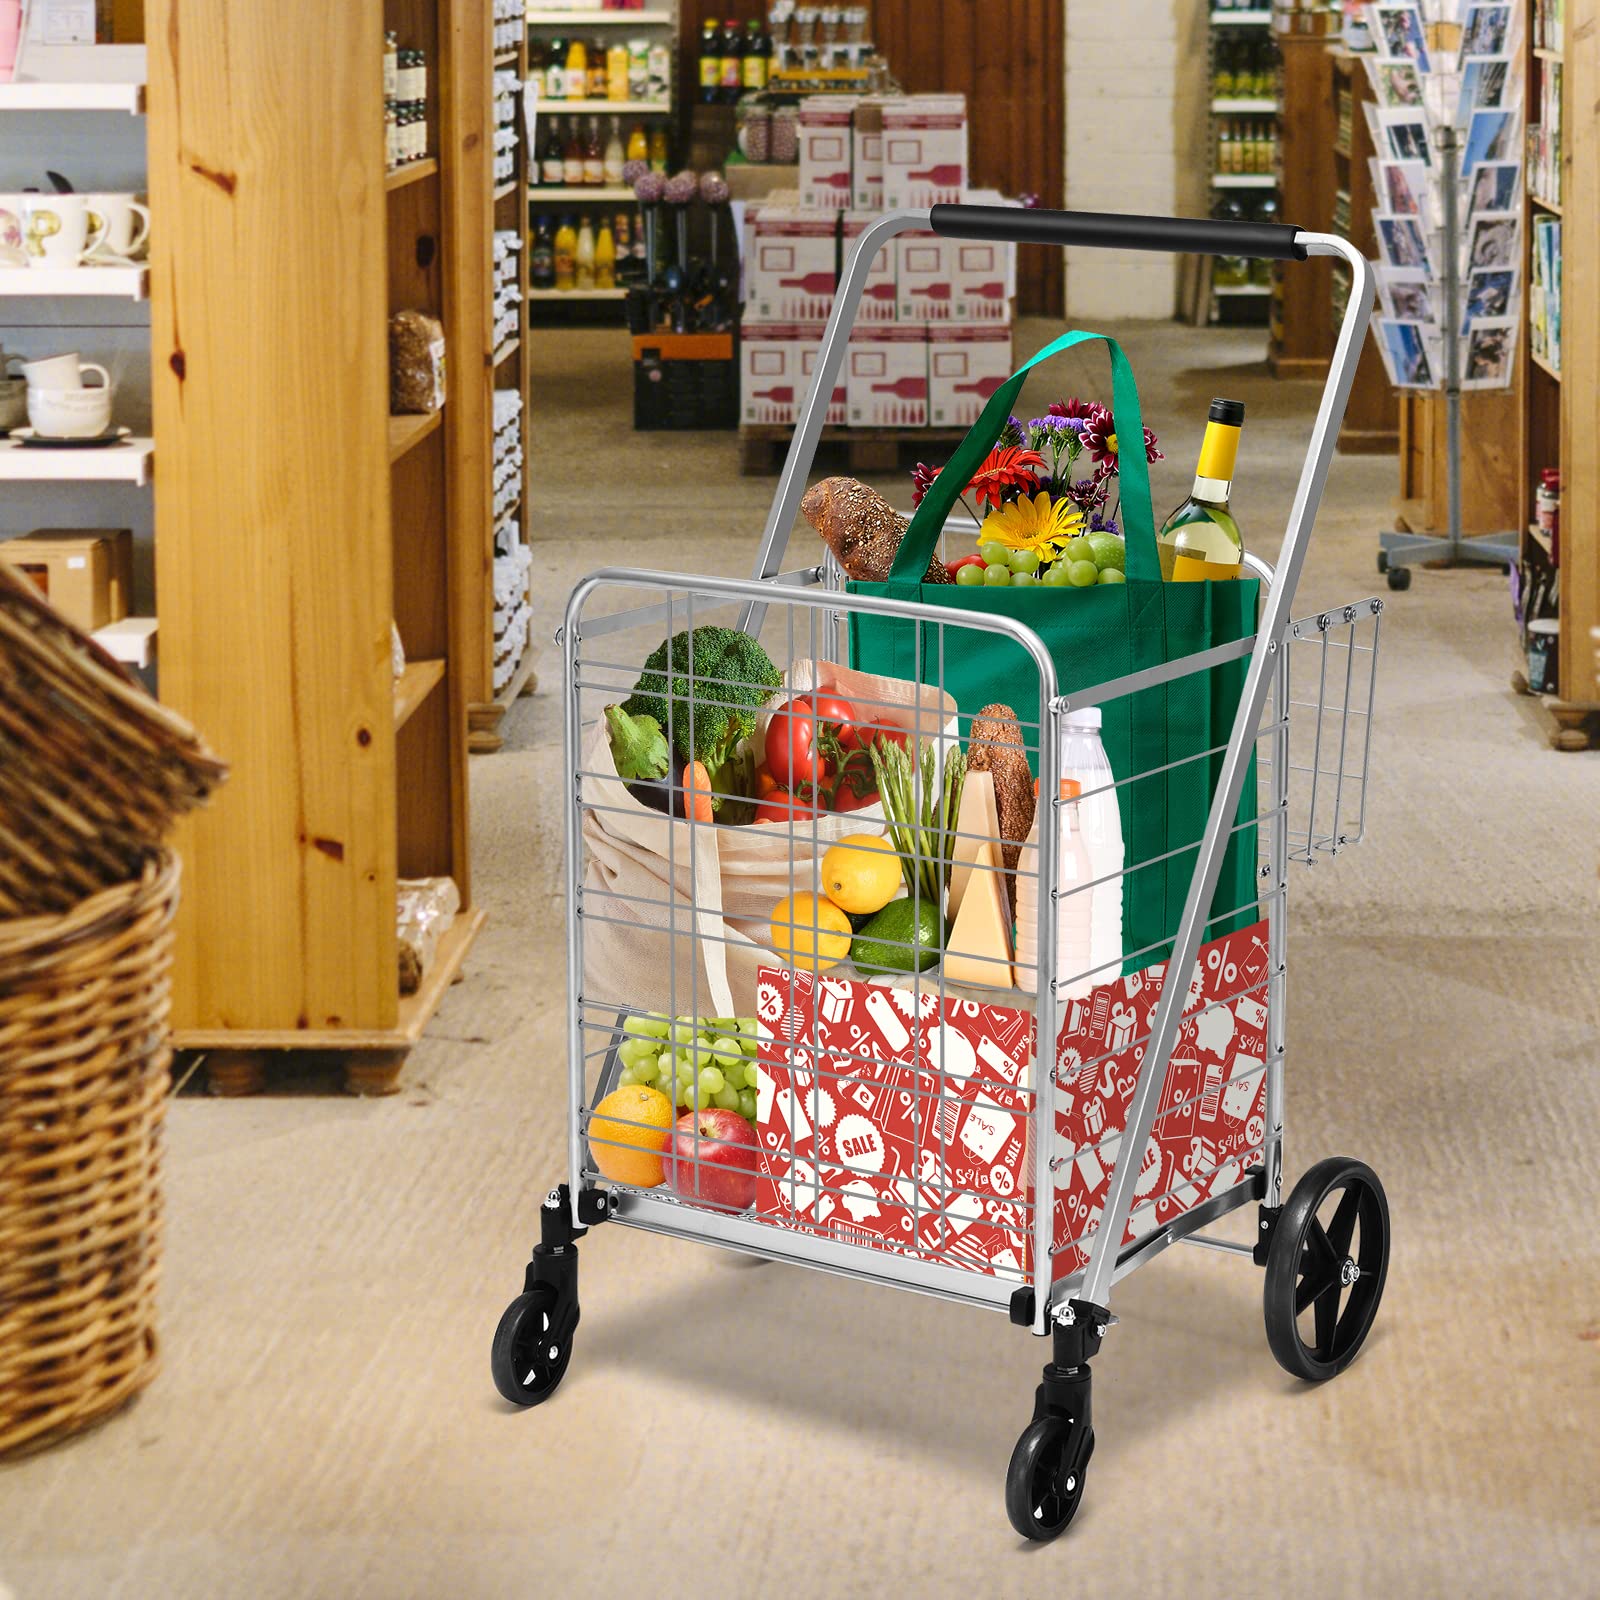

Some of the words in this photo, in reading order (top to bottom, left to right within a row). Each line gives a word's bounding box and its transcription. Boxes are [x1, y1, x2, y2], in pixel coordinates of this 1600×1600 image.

[842, 1133, 878, 1158] SALE
[1004, 1137, 1023, 1167] SALE
[1052, 1227, 1071, 1250] ALE
